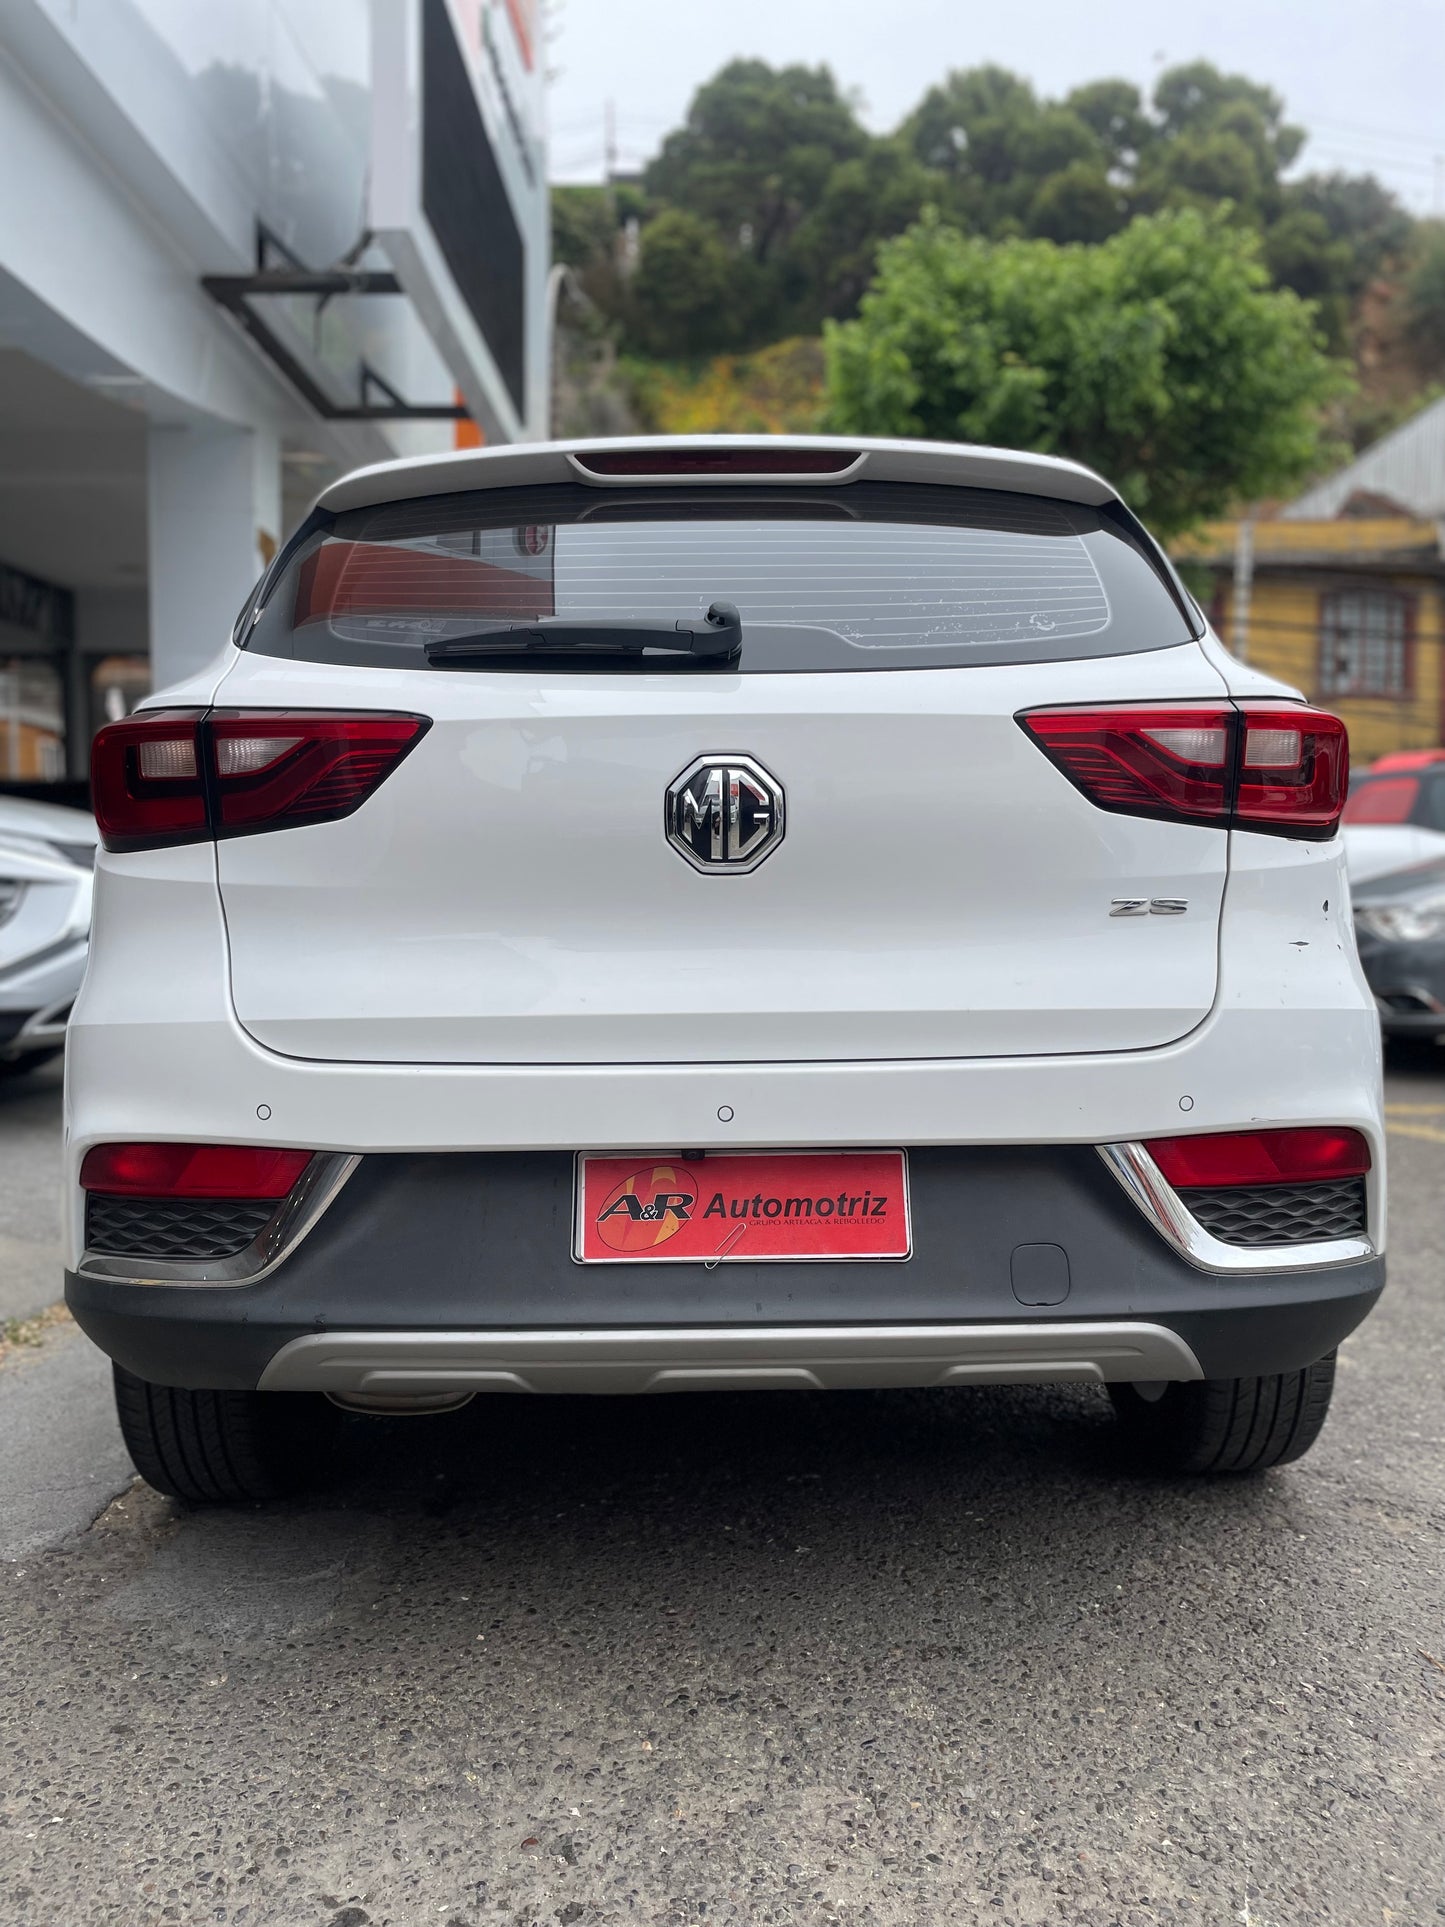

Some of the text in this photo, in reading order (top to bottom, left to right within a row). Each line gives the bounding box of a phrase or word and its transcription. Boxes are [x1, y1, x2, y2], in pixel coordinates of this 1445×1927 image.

[682, 769, 770, 860] MG
[1109, 897, 1190, 917] ZS
[596, 1191, 888, 1222] A&R Automotriz
[833, 1217, 886, 1225] REBOLLEDO
